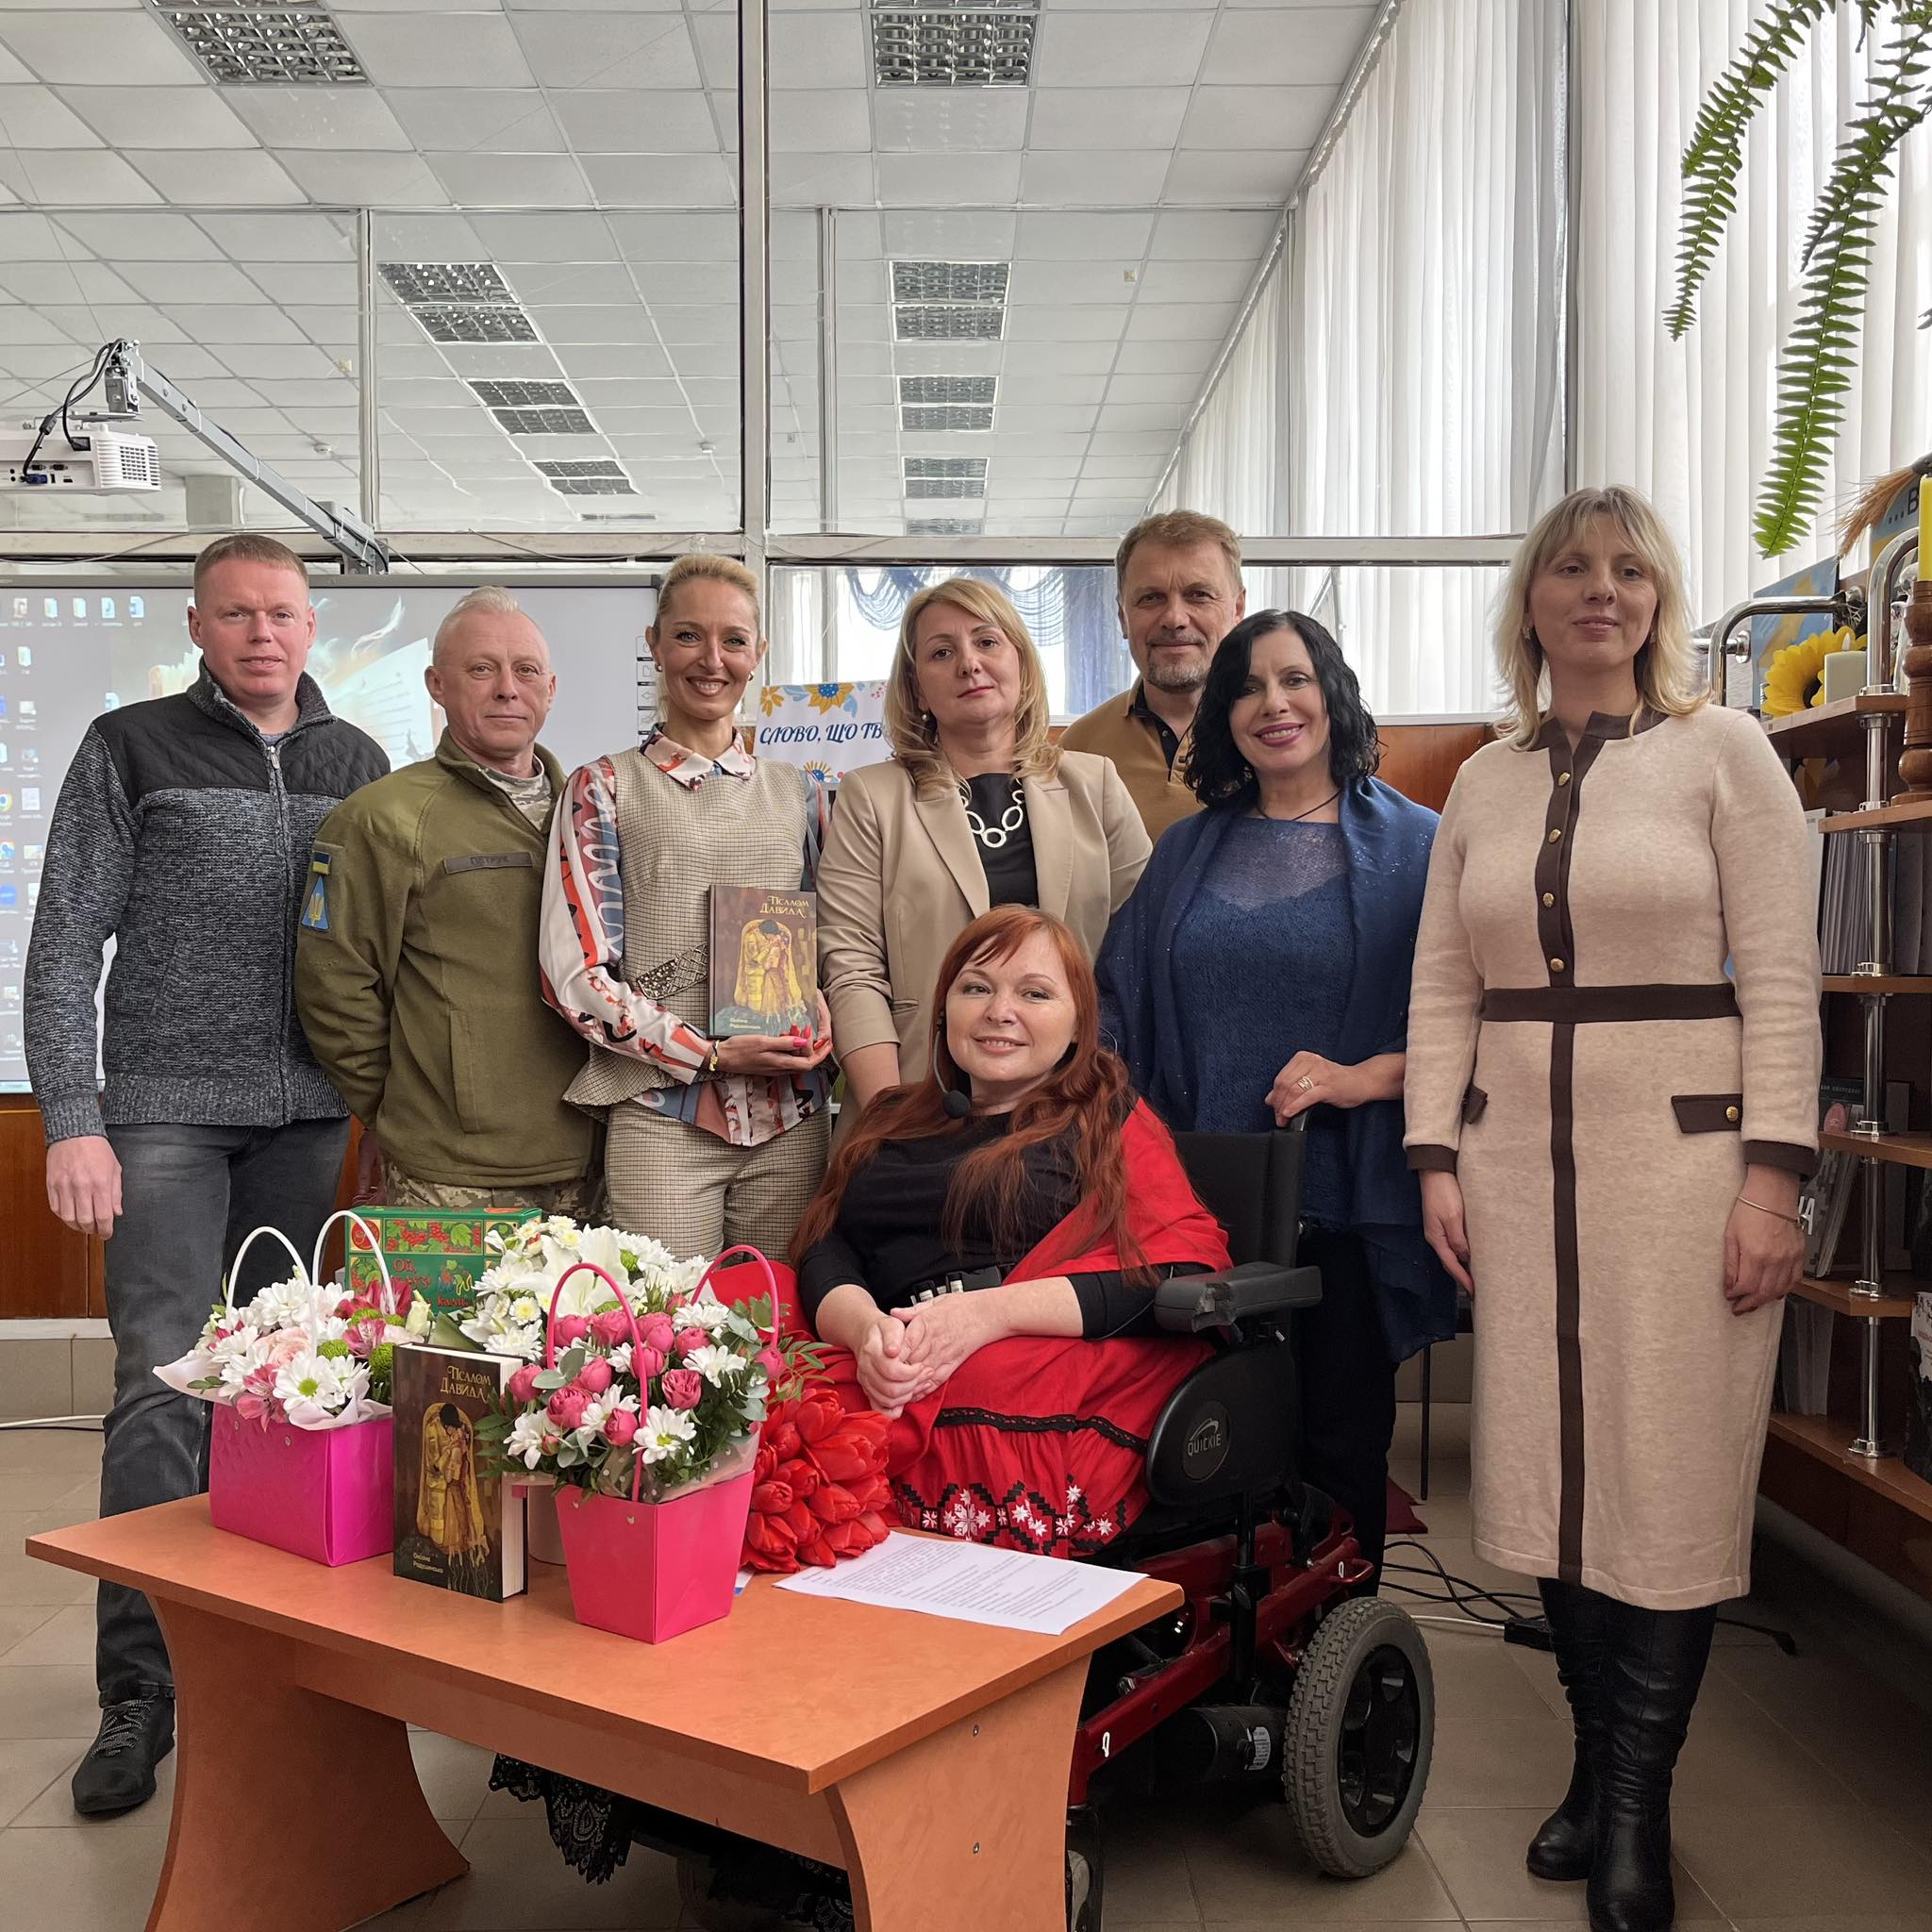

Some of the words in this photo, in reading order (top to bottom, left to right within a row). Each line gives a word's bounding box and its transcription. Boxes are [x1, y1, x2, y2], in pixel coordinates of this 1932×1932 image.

[759, 724, 821, 745] СЛОВО,
[825, 723, 858, 743] ЩО
[447, 1365, 491, 1386] ПСАЛОМ
[1187, 1433, 1222, 1457] QUICKIE
